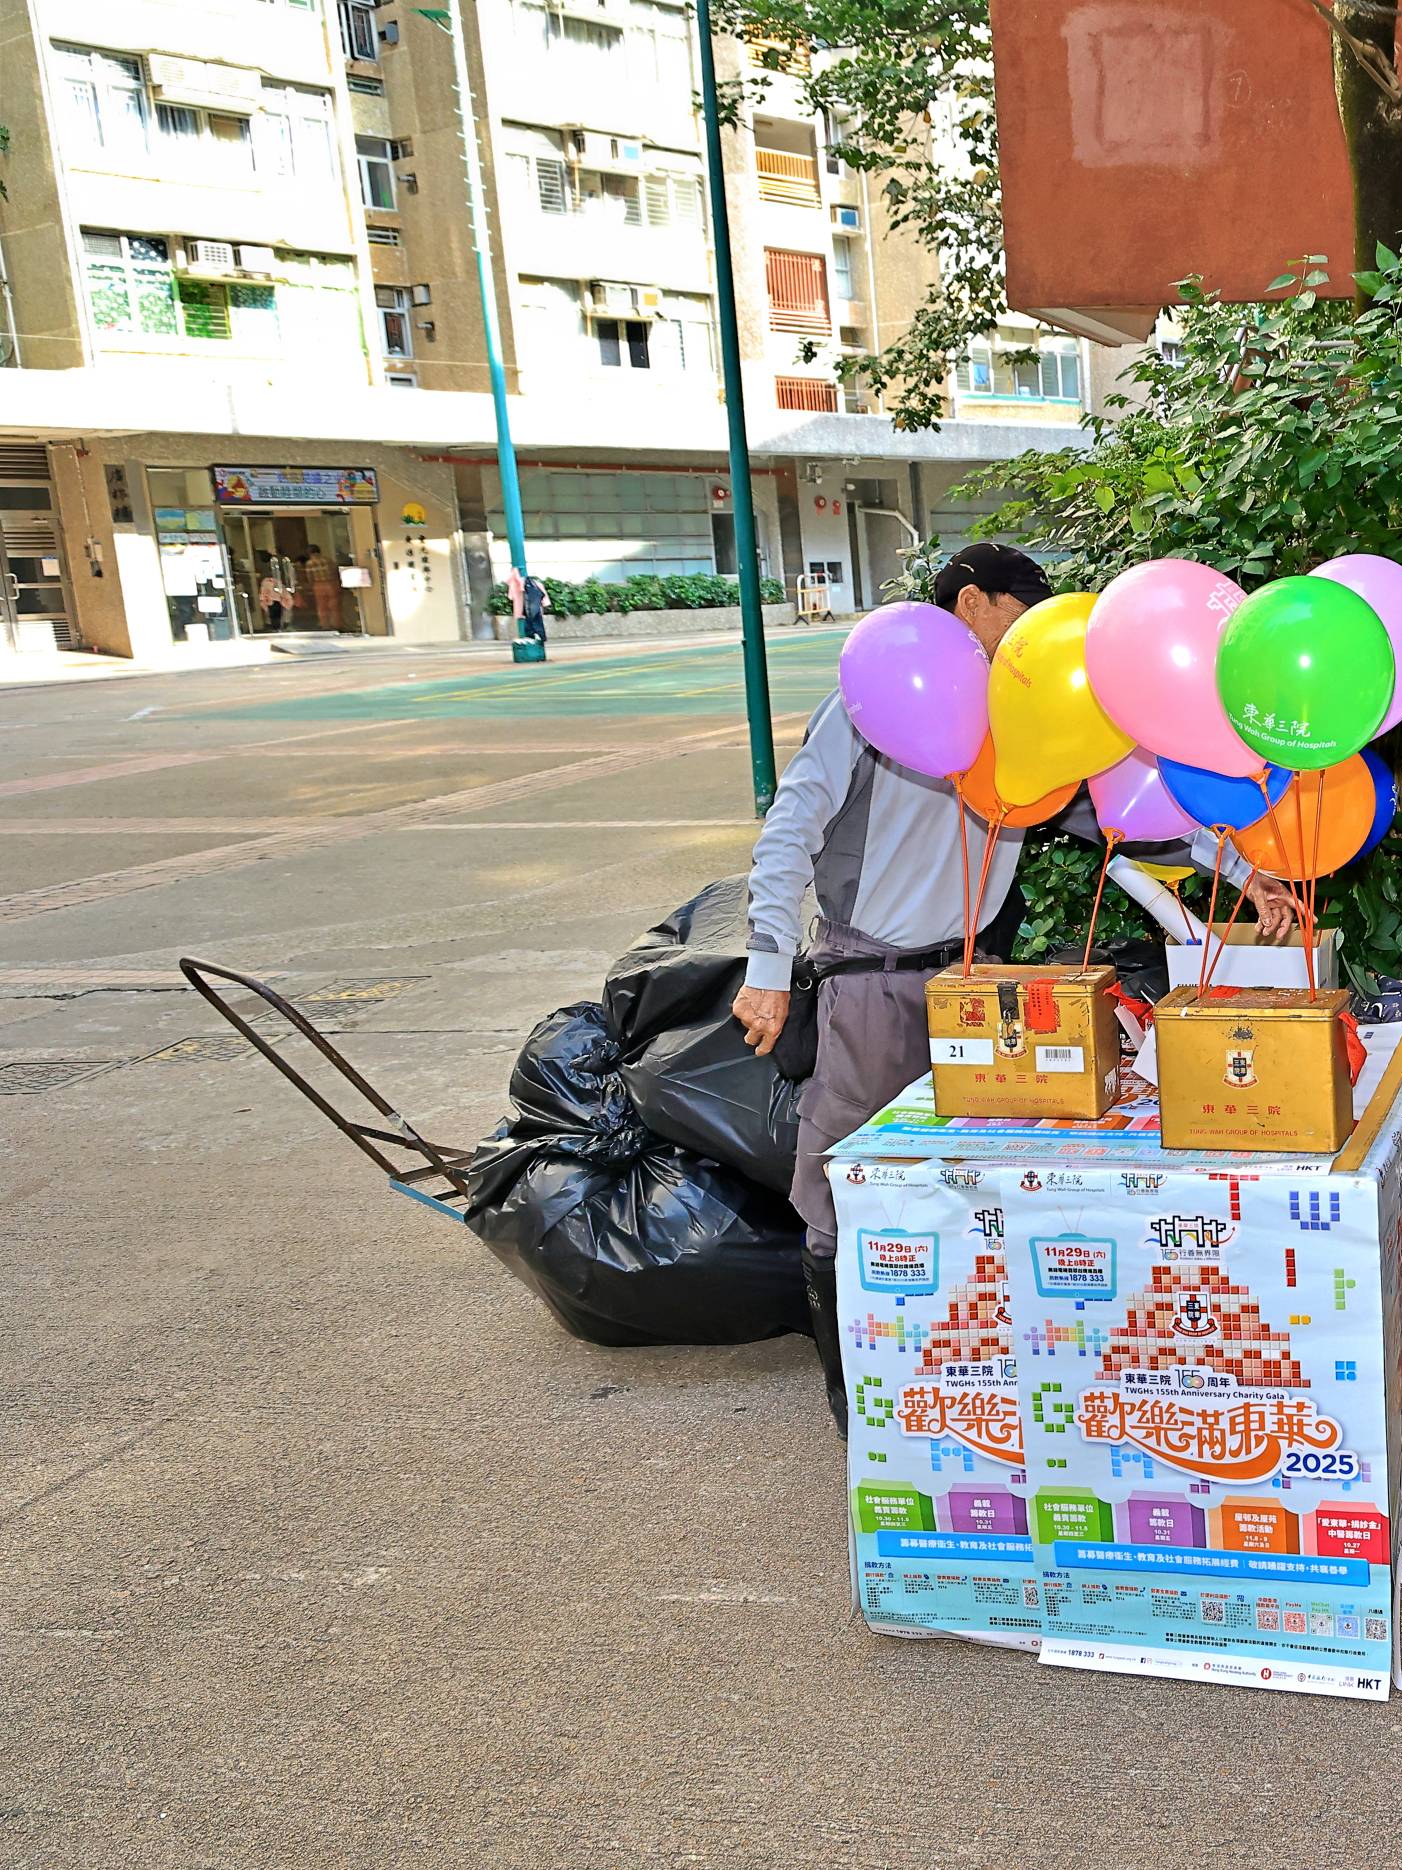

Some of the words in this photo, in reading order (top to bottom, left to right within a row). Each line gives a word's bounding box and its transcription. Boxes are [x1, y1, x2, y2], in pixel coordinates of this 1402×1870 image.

[1243, 703, 1311, 737] 東華三院
[1228, 711, 1244, 730] Tung
[1244, 723, 1261, 738] Wah
[1261, 732, 1286, 747] Group
[1286, 739, 1297, 748] of
[1297, 740, 1337, 750] Hospitals
[949, 1045, 965, 1058] 21
[974, 1072, 1049, 1084] 東華三院
[1028, 1097, 1065, 1105] HOSPITALS
[1202, 1104, 1281, 1116] 東華三院
[868, 1240, 912, 1253] 11月29日
[914, 1245, 928, 1254] (六)
[880, 1254, 917, 1263] 晚上8時正
[1044, 1247, 1090, 1258] 11月29日
[1093, 1251, 1106, 1260] (六)
[1058, 1258, 1095, 1267] 晚上8時正
[890, 1269, 908, 1277] 1878
[910, 1269, 926, 1277] 333
[1069, 1274, 1087, 1282] 1878
[1089, 1274, 1104, 1282] 333
[946, 1365, 994, 1377] 東華三院
[946, 1379, 976, 1387] TWGHs
[977, 1379, 1002, 1387] 155th
[1124, 1373, 1172, 1386] 東華三院
[1207, 1376, 1231, 1388] 周年
[1125, 1387, 1154, 1395] TWGHs
[1156, 1388, 1179, 1396] 155th
[1181, 1390, 1231, 1399] Anniversary
[1233, 1391, 1264, 1401] Charity
[1265, 1392, 1285, 1400] Gala
[1078, 1391, 1338, 1462] 歡樂滿東華
[1286, 1453, 1354, 1475] 2025
[864, 1495, 915, 1506] 社會服務單位
[1043, 1503, 1094, 1513] 社會服務單位
[1327, 1529, 1371, 1541] 中醫籌款日
[864, 1561, 892, 1569] 捐款方法
[1042, 1571, 1070, 1579] 捐款方法
[1068, 1649, 1083, 1657] 1878
[1357, 1677, 1382, 1690] HKT
